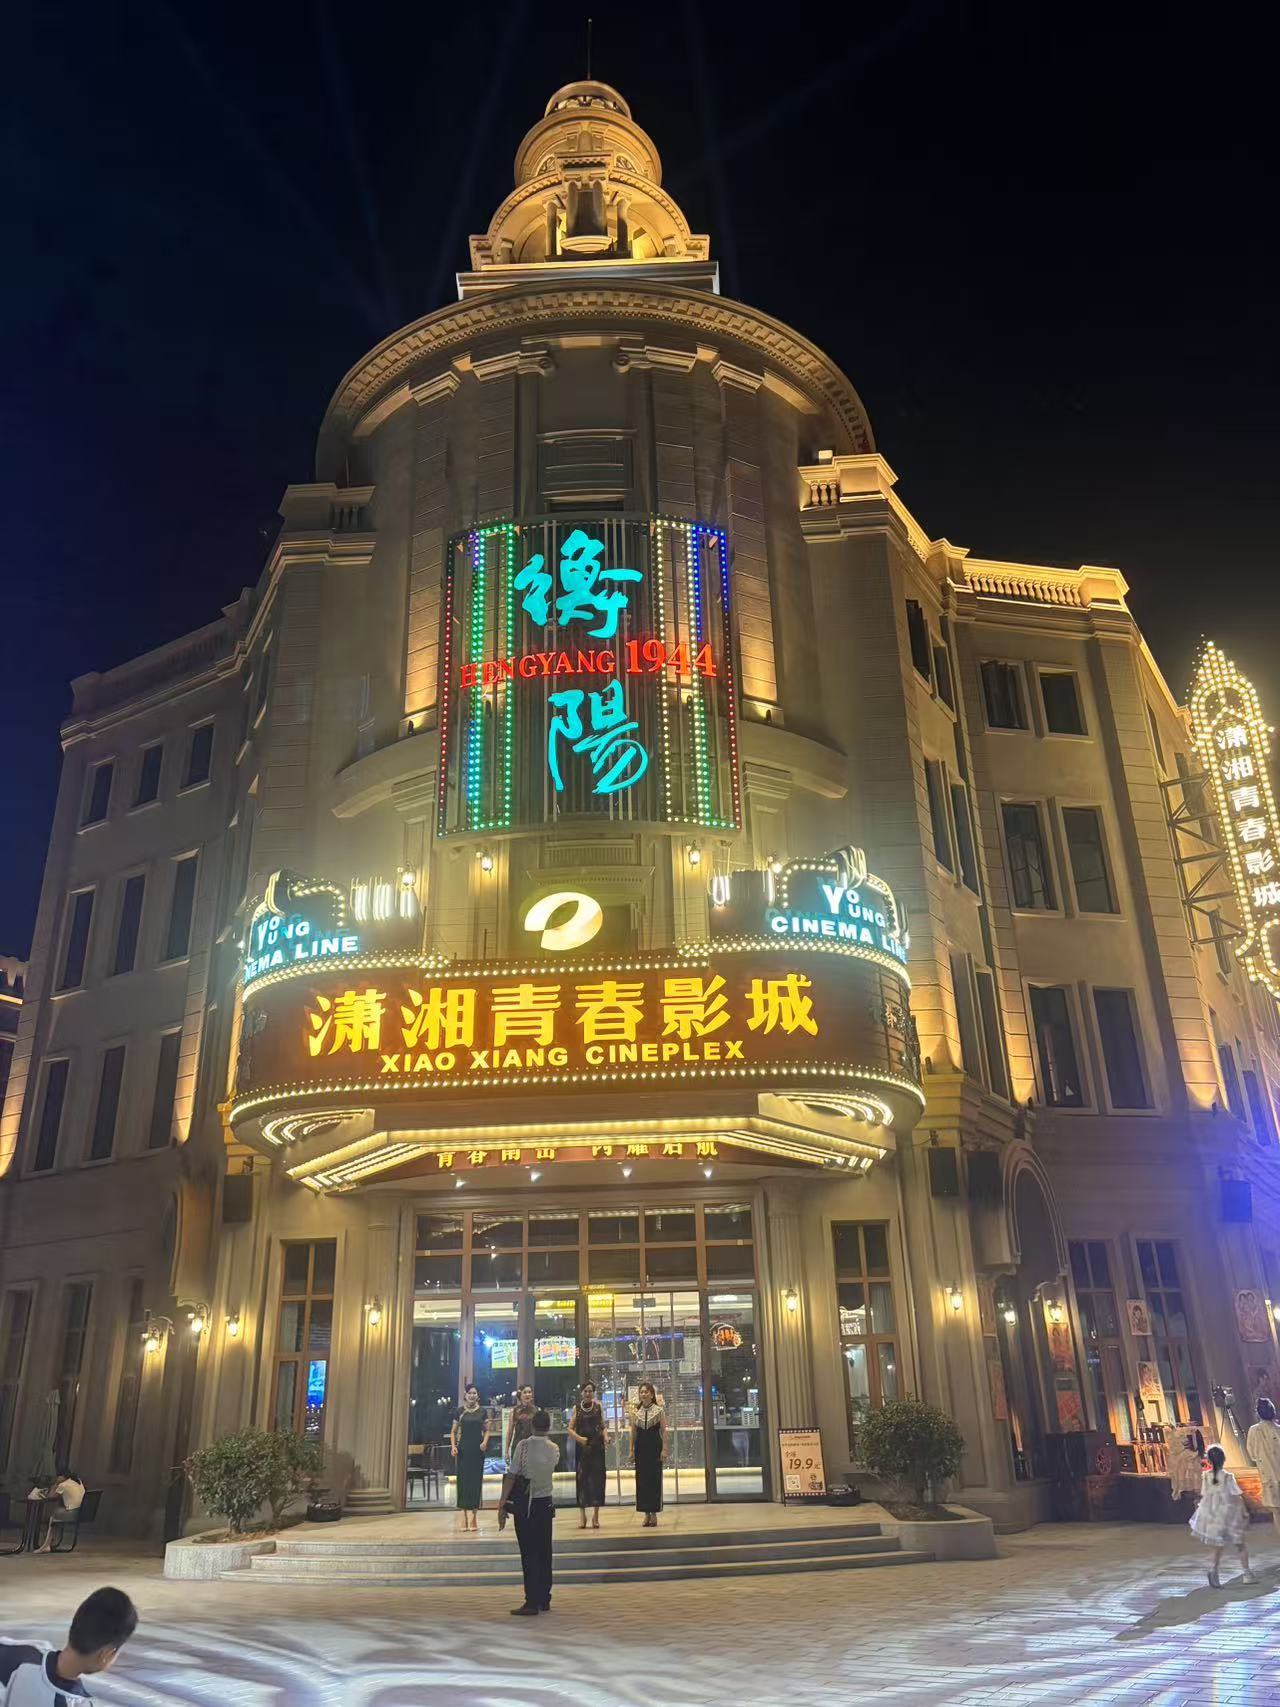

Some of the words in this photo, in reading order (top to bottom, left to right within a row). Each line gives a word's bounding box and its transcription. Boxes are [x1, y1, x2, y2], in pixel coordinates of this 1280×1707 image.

[460, 650, 616, 688] HENGYANG
[625, 639, 717, 677] 1944
[771, 916, 874, 944] CINEMA
[295, 936, 358, 960] LINE
[308, 973, 819, 1057] 潇湘青春影城
[381, 1051, 455, 1073] XIAO
[470, 1047, 568, 1069] XIANG
[586, 1040, 745, 1065] CINEPLEX
[789, 1458, 813, 1469] 19.9
